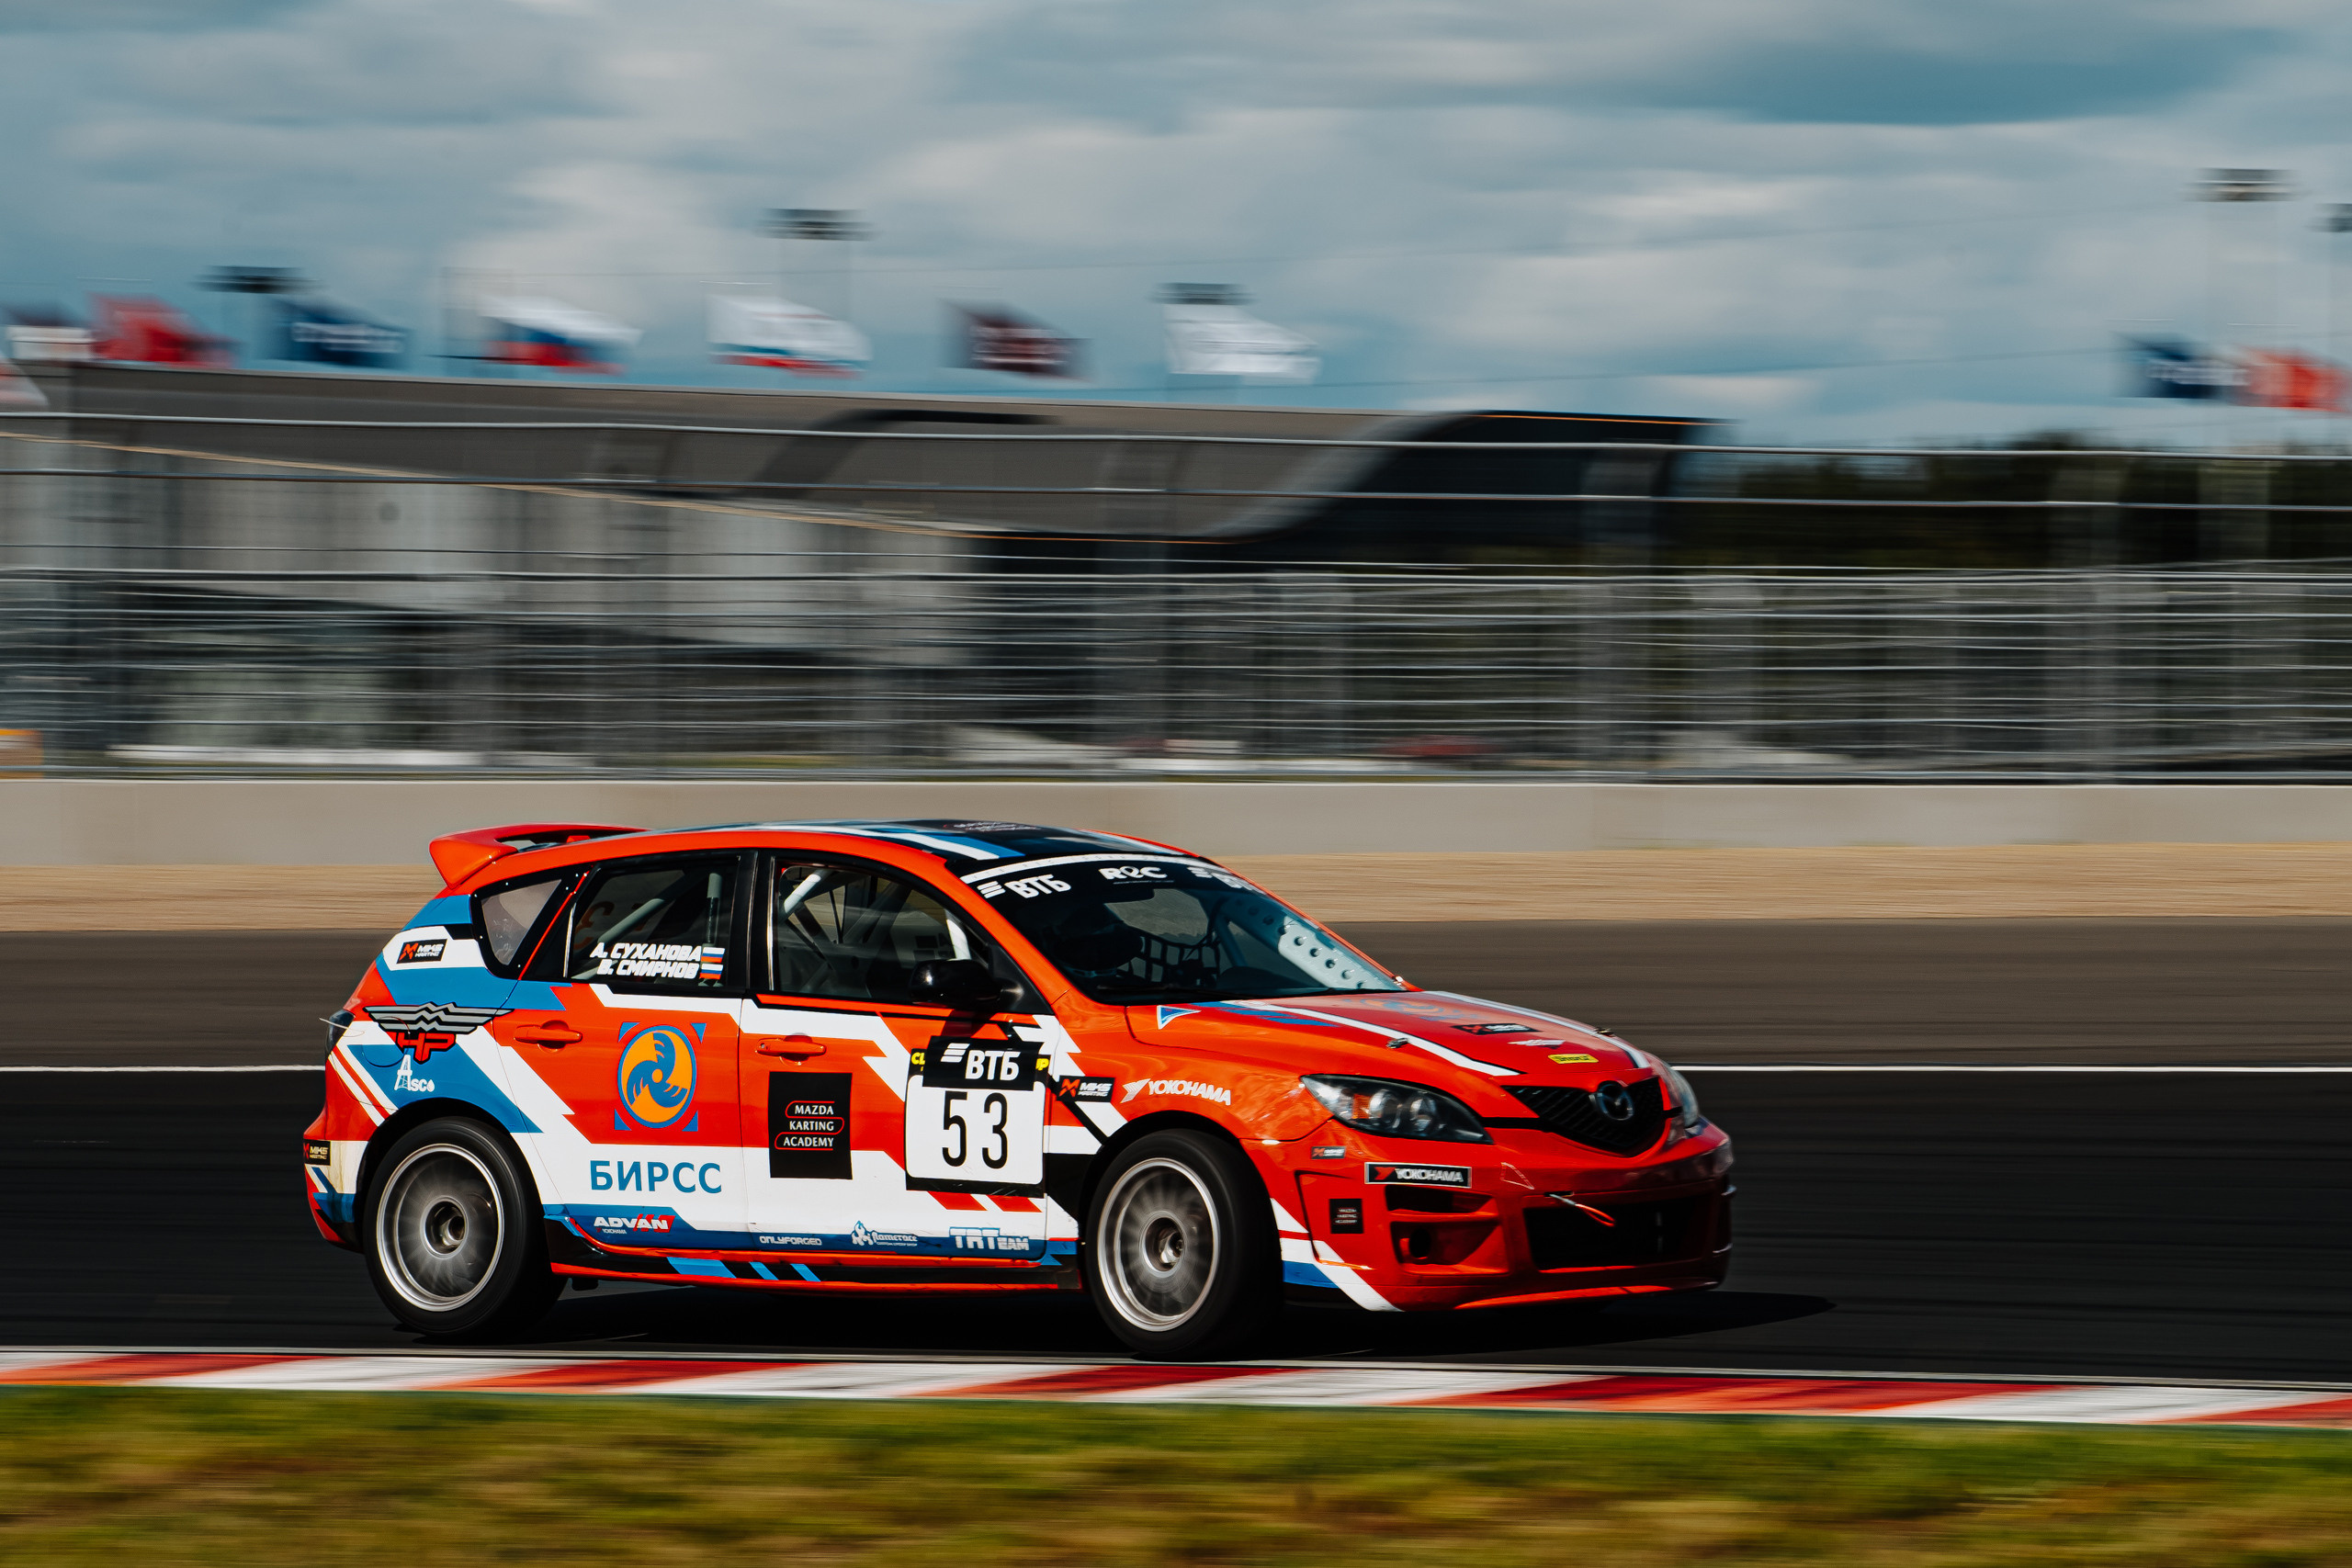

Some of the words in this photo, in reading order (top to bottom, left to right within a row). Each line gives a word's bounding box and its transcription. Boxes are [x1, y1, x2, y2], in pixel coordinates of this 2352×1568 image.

[1004, 874, 1072, 899] ВТБ
[589, 942, 609, 958] А.
[610, 942, 702, 962] СУХАНОВА
[616, 960, 700, 979] СМИРНОВ
[965, 1050, 1021, 1081] ВТБ
[1148, 1079, 1232, 1106] YOKOHAMA
[794, 1104, 834, 1115] MAZDA
[789, 1121, 834, 1132] KARTING
[942, 1090, 1008, 1170] 53
[783, 1136, 834, 1147] ACADEMY
[590, 1159, 722, 1194] БИРСС
[1395, 1168, 1464, 1183] YOKOHAMA
[594, 1216, 669, 1230] ADVAN
